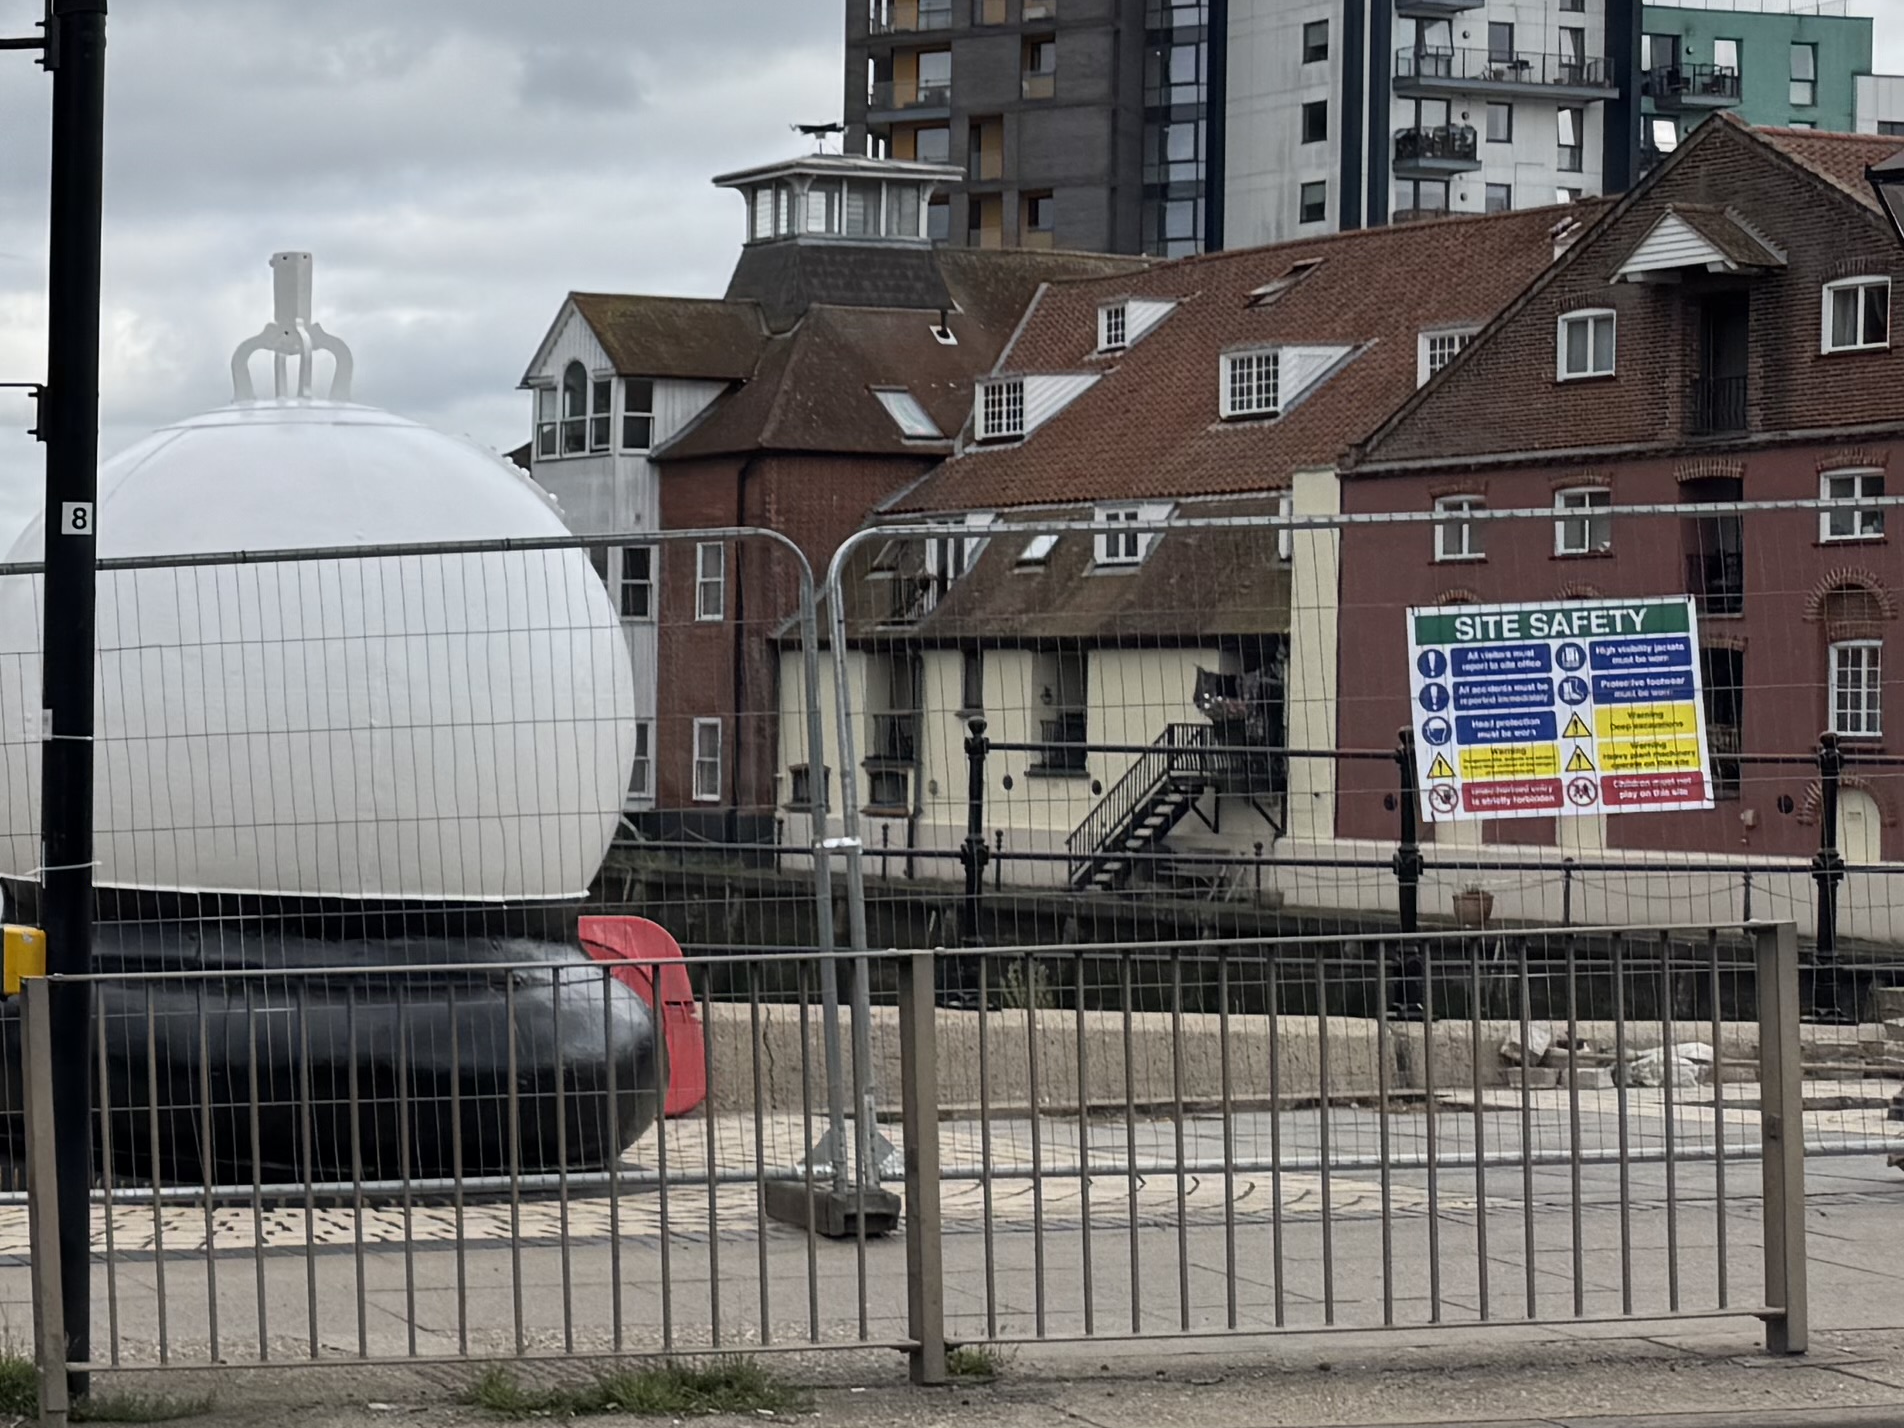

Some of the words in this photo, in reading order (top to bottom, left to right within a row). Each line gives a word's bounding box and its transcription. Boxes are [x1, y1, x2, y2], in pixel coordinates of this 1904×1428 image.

[72, 507, 87, 529] 8
[1454, 614, 1521, 641] SITE
[1529, 608, 1647, 637] SAFETY
[1617, 644, 1652, 655] visibility
[1653, 643, 1685, 654] jackets
[1517, 659, 1541, 668] office
[1635, 655, 1646, 663] be
[1537, 682, 1548, 690] be
[1627, 712, 1664, 720] Warning
[1496, 717, 1541, 728] protection
[1501, 729, 1513, 737] be
[1630, 741, 1667, 750] Warning
[1613, 779, 1650, 788] Children
[1620, 790, 1637, 799] play
[1481, 796, 1511, 806] strictly
